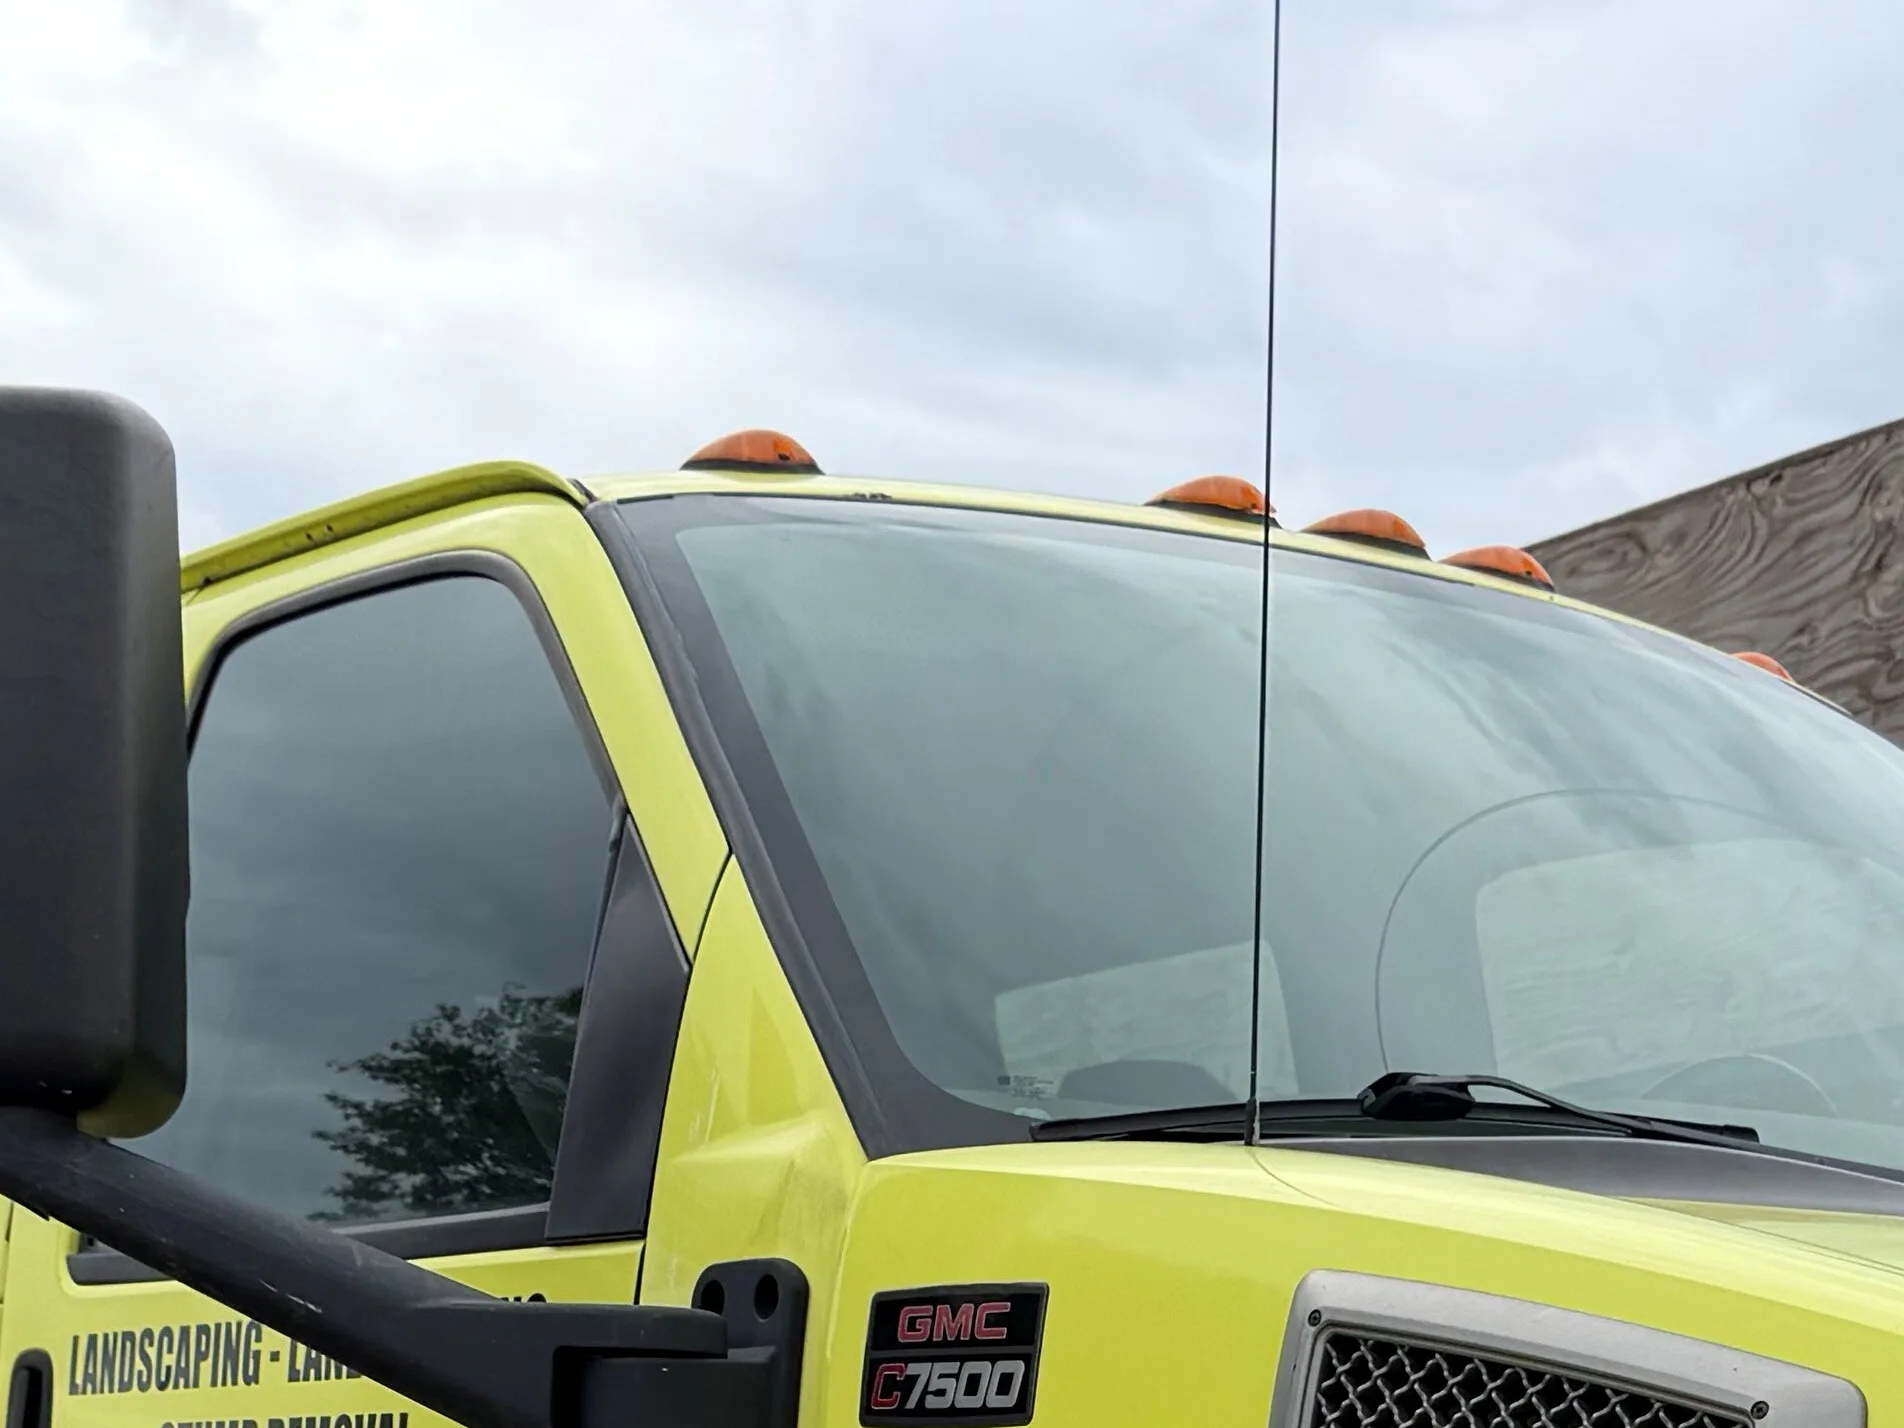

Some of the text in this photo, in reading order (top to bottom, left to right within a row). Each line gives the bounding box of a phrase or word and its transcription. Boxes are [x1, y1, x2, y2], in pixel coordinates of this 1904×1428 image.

[897, 1302, 1011, 1342] GMC
[69, 1319, 263, 1397] LANDSCAPING
[871, 1360, 1025, 1410] C7500
